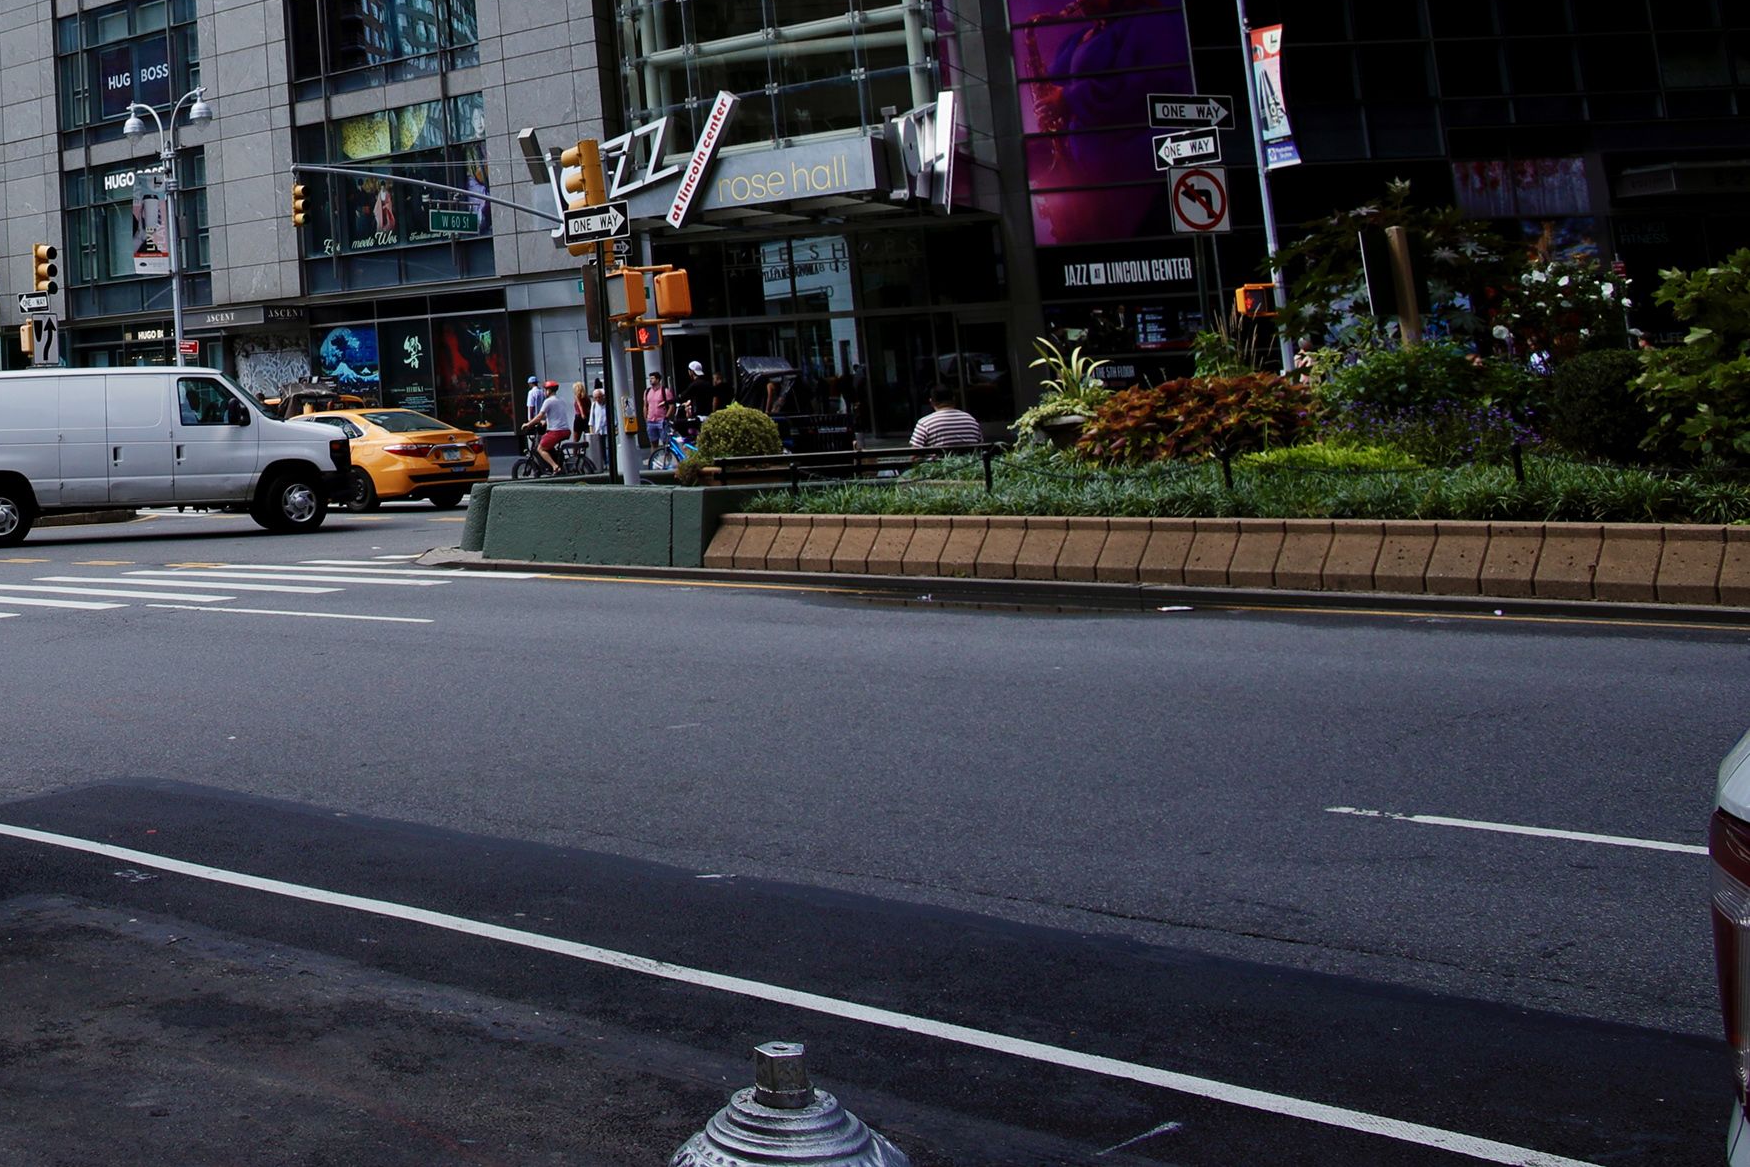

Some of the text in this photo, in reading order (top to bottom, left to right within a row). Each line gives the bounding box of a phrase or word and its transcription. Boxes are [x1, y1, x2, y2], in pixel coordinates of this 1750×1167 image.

[108, 63, 169, 90] HUG BOSS
[1161, 104, 1220, 118] ONE WAY
[702, 98, 728, 149] center
[1163, 139, 1210, 158] ONE WAY
[104, 171, 135, 190] HUGO
[677, 150, 707, 204] lincoln
[718, 155, 848, 203] rose hall
[441, 216, 470, 228] W 60 St
[671, 204, 684, 221] at
[573, 214, 618, 233] ONE WAY
[1641, 221, 1666, 233] NOT
[351, 236, 374, 250] meets
[375, 230, 398, 246] Wes
[1064, 263, 1089, 286] JAZZ
[1106, 260, 1151, 284] LINCOLN
[1151, 257, 1193, 282] CENTER
[22, 298, 46, 307] ONE WAY
[206, 313, 235, 323] ASCENT
[268, 308, 305, 318] ASCENT
[138, 330, 157, 340] HUGO
